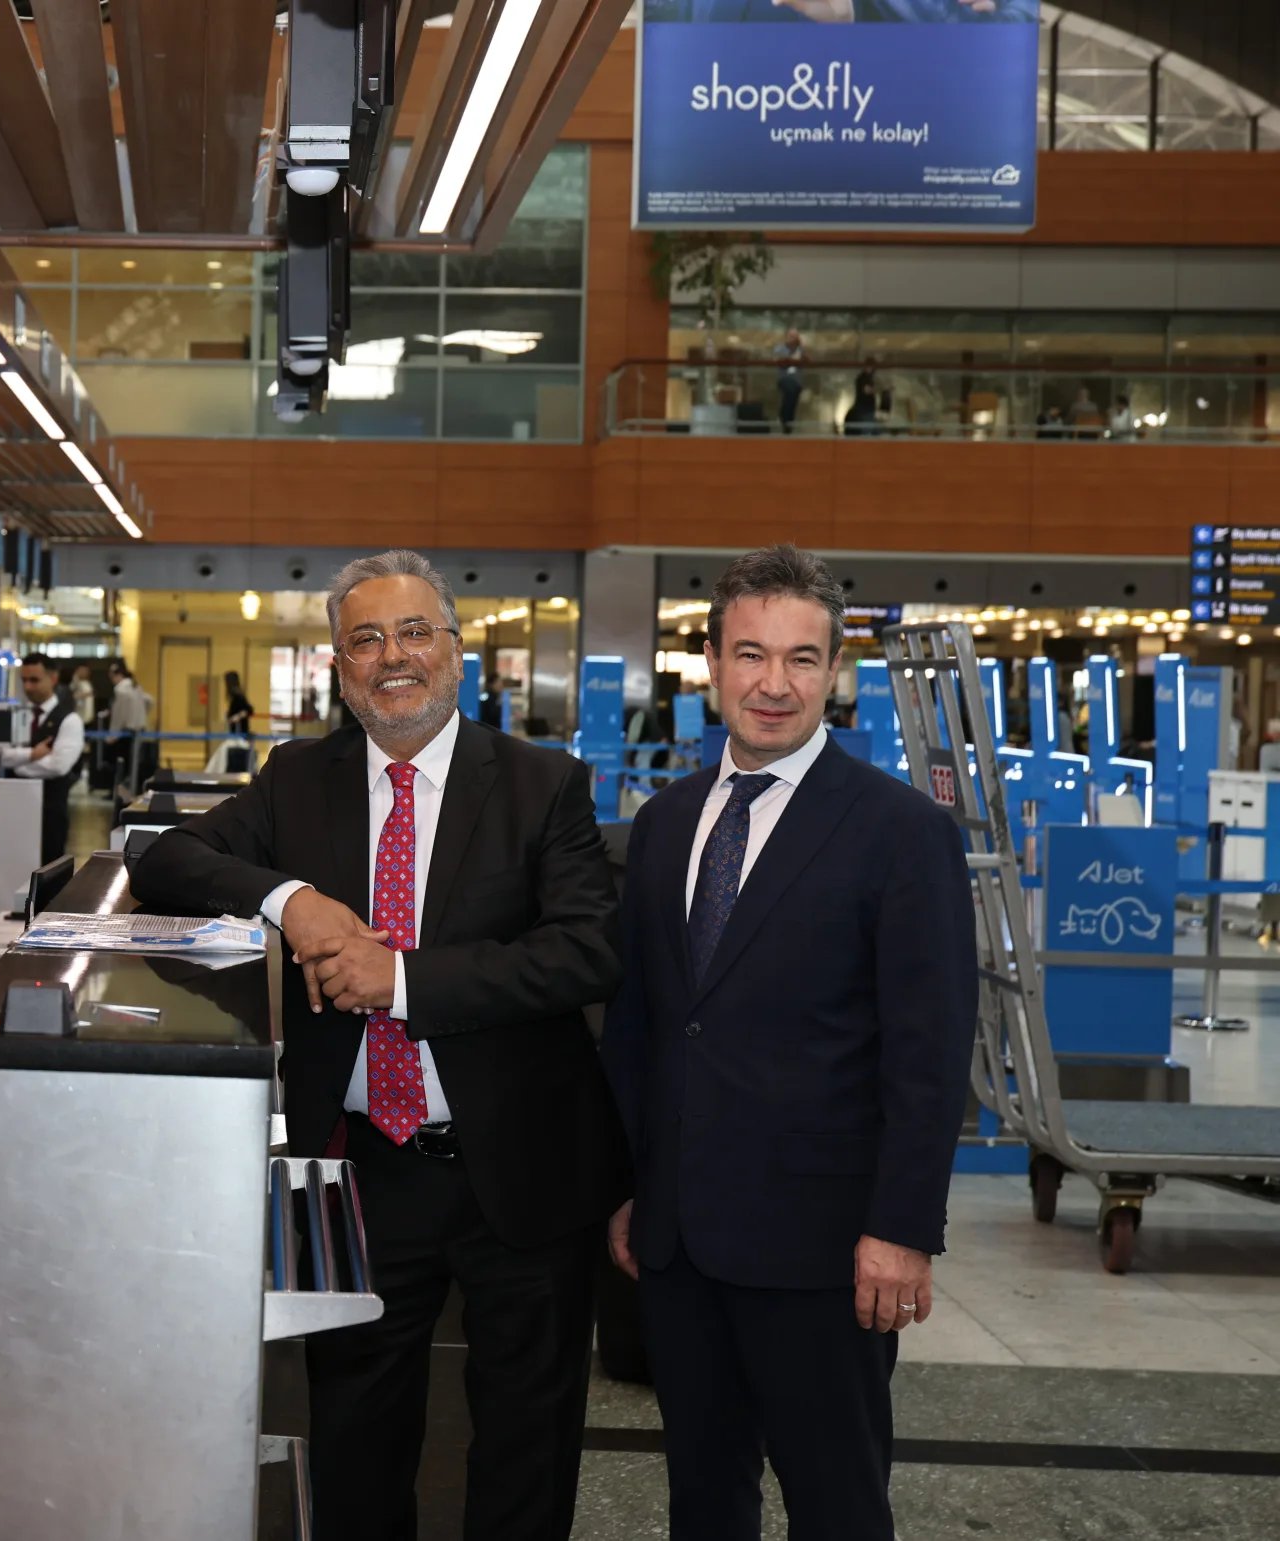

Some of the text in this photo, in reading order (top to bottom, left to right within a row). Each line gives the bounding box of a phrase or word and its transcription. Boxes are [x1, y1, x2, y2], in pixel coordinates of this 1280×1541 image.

[691, 61, 874, 123] shop&fly
[770, 121, 928, 147] uçmak ne kolay!
[1078, 860, 1144, 885] AJet
